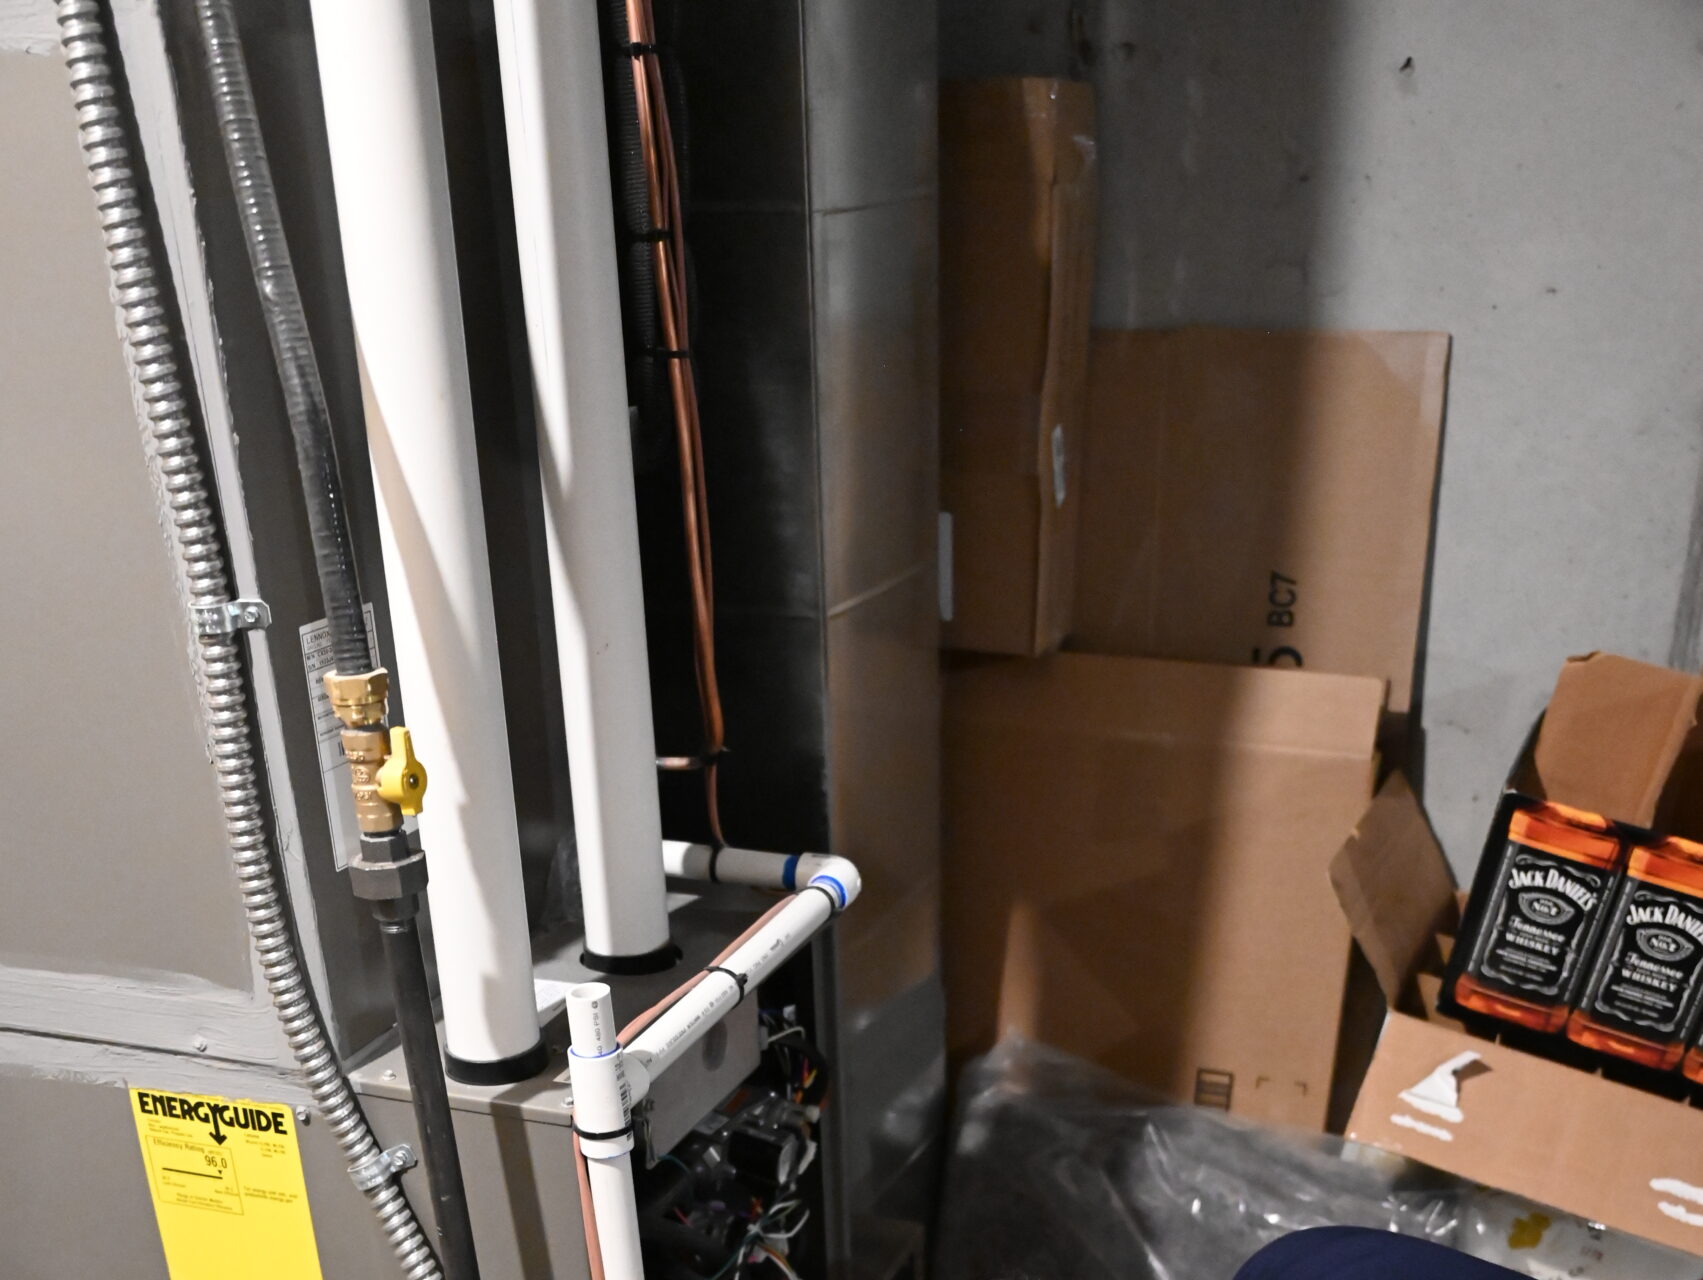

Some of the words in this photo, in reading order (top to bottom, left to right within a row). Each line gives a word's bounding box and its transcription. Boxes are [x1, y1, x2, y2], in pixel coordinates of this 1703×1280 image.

[1267, 571, 1297, 627] BC7
[1508, 867, 1544, 889] JACK
[1626, 903, 1664, 925] JACK
[1508, 915, 1566, 942] Tennessee
[1506, 932, 1559, 955] WHISKEY
[1625, 951, 1683, 980] Tennessee
[1621, 968, 1678, 993] WHISKEY
[204, 1154, 228, 1170] 96.0
